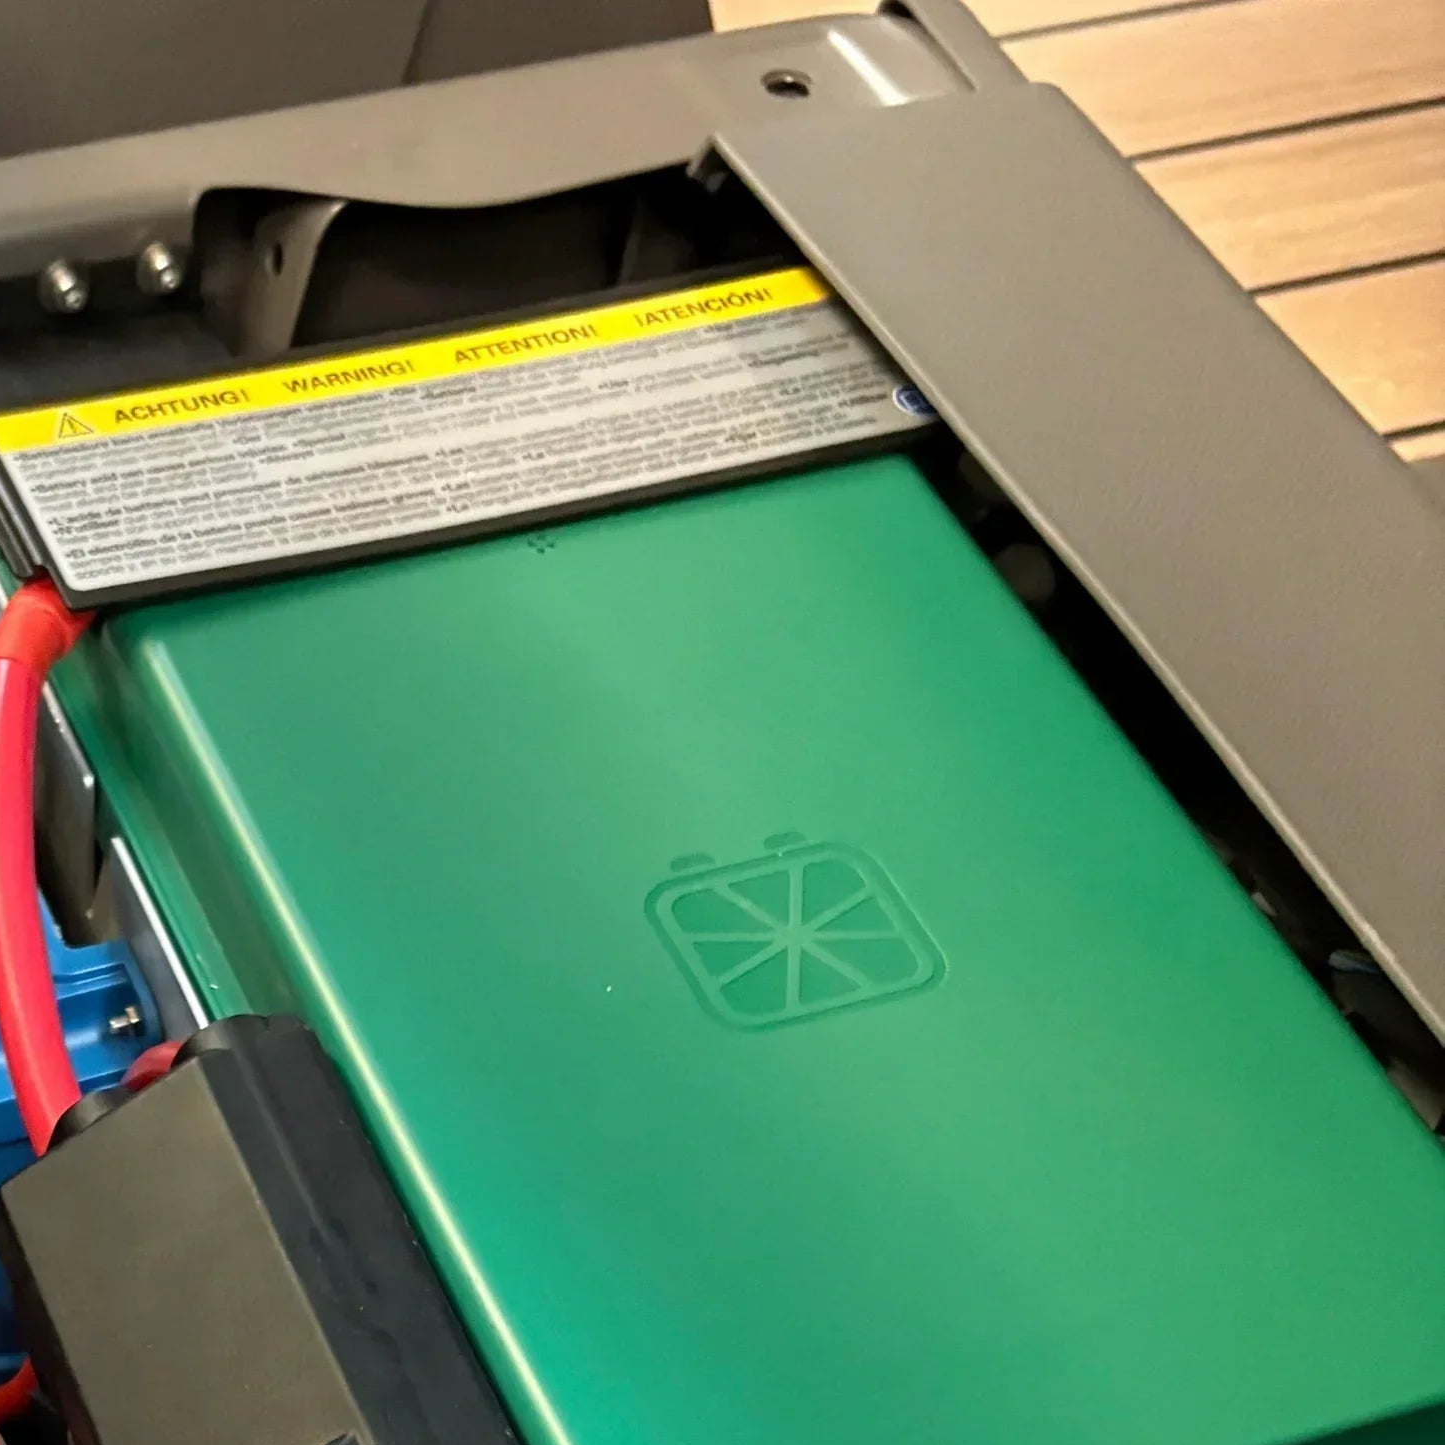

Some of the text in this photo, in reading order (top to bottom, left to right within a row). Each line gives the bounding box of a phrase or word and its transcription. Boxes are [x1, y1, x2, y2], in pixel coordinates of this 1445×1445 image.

[113, 388, 249, 424] ACHTUNG!
[283, 359, 415, 394] WARNING!
[454, 324, 597, 364] ATTENTION!
[635, 287, 773, 328] ¡ATENCIÓN!
